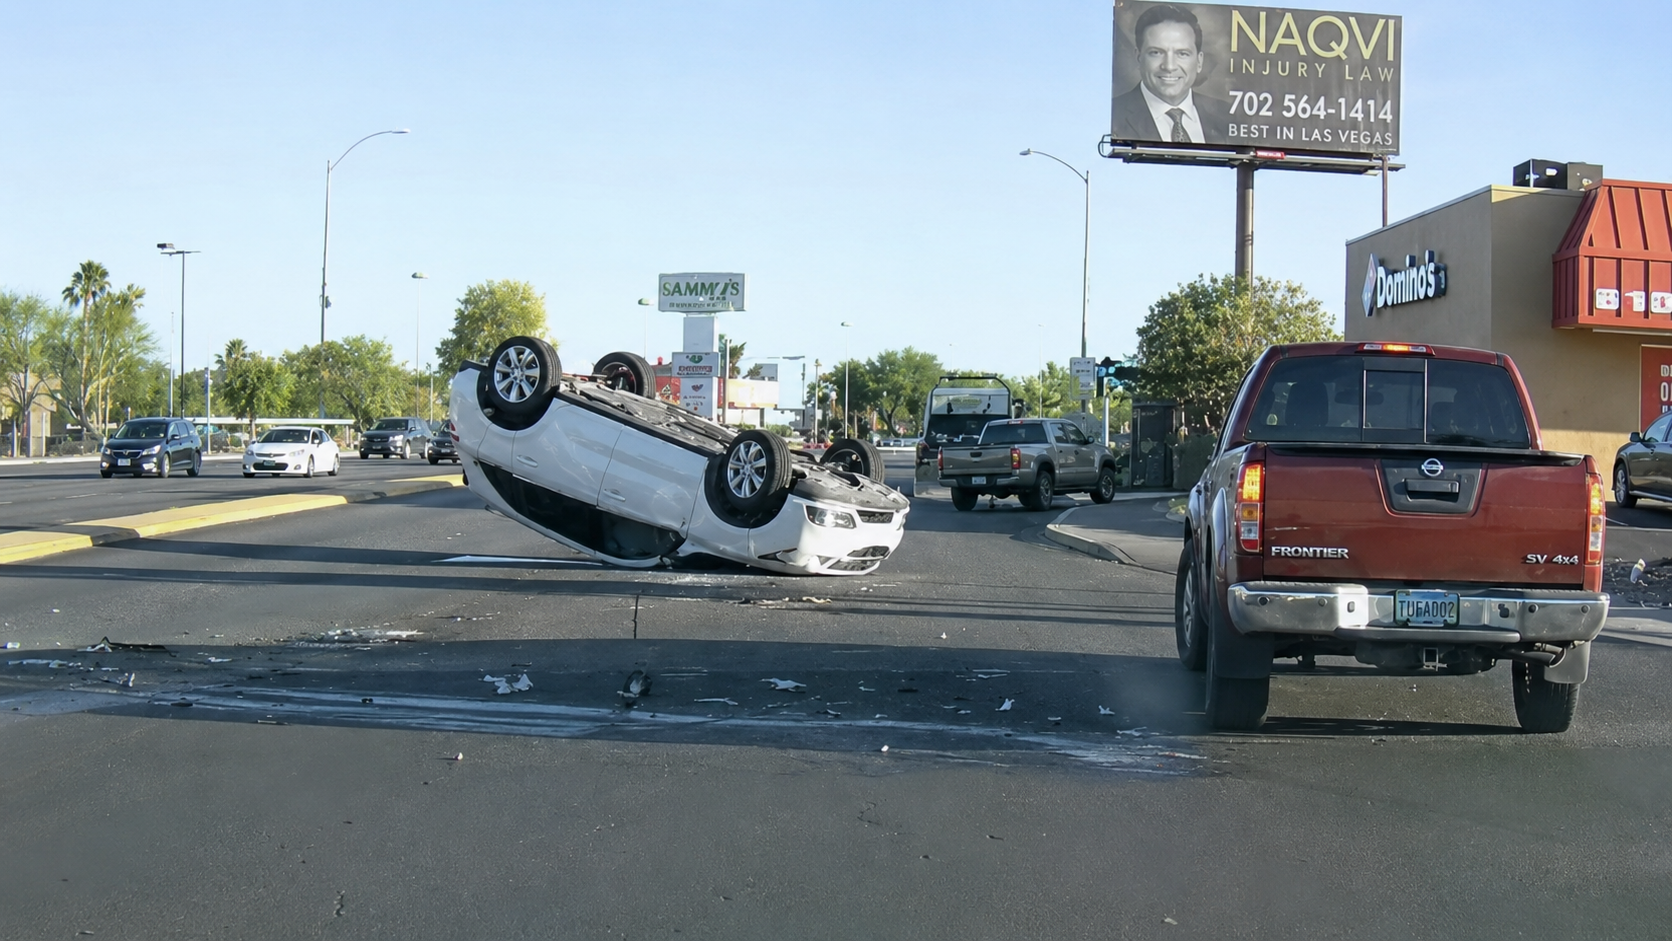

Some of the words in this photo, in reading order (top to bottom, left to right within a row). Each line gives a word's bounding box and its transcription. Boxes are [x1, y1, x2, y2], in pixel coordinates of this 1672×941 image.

[1231, 9, 1396, 61] NAQVI
[1230, 58, 1326, 78] INJURY
[1345, 66, 1394, 82] LAW
[1228, 91, 1273, 117] 702
[1282, 95, 1393, 123] 564-1414
[1228, 123, 1270, 139] BEST
[1276, 125, 1295, 141] IN
[1301, 127, 1332, 142] LAS
[1337, 129, 1393, 146] VEGAS
[1376, 249, 1435, 308] Domino's
[1271, 546, 1350, 560] FRONTIER
[1525, 553, 1548, 565] SV
[1552, 554, 1579, 566] 4x4
